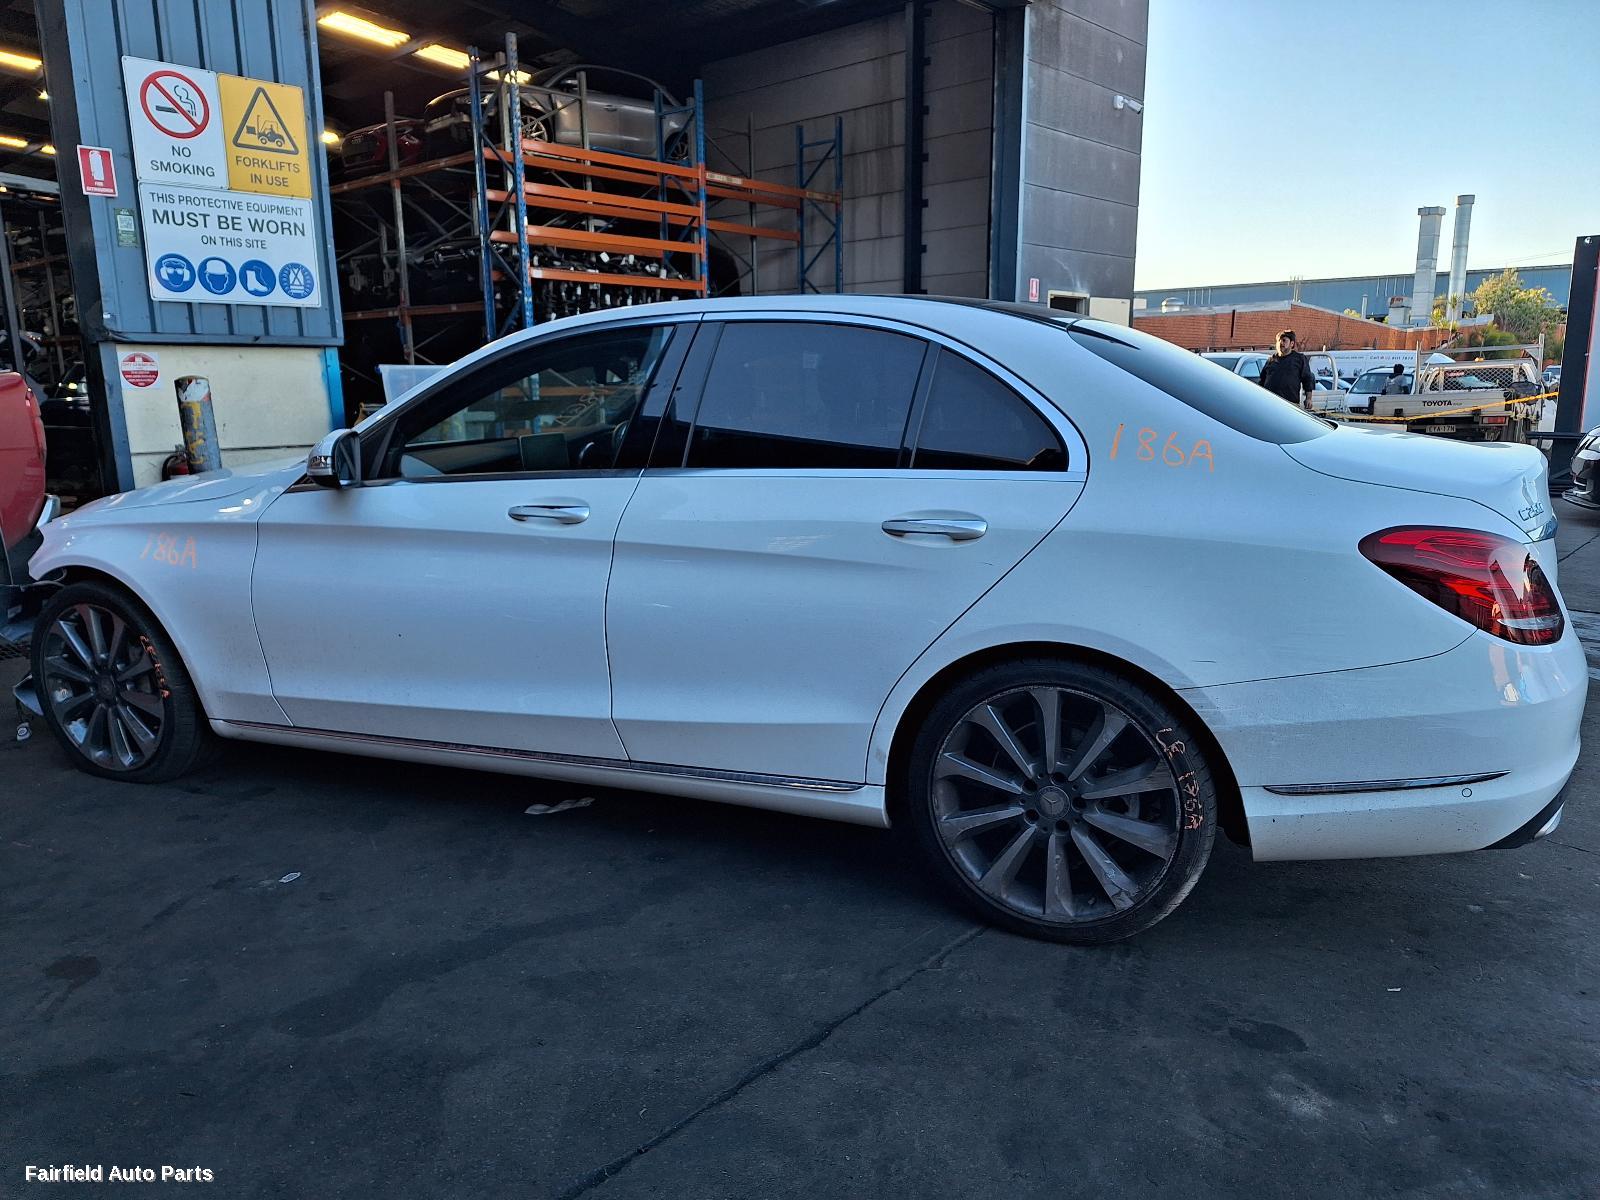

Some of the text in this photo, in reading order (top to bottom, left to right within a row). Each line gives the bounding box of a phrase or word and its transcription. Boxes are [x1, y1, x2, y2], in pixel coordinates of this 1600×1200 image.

[171, 145, 192, 158] NO
[150, 160, 215, 177] SMOKING
[235, 155, 300, 174] FORKLIFTS
[250, 173, 289, 187] IN USE
[149, 191, 304, 217] THIS PROTECTIVE EQUIPMENT
[152, 208, 211, 229] MUST
[217, 215, 243, 232] BE
[248, 218, 306, 237] WORN
[201, 235, 268, 250] ON THIS SITE
[1422, 399, 1453, 407] TOYOTA
[1110, 423, 1215, 472] 186A
[139, 532, 197, 569] 186A
